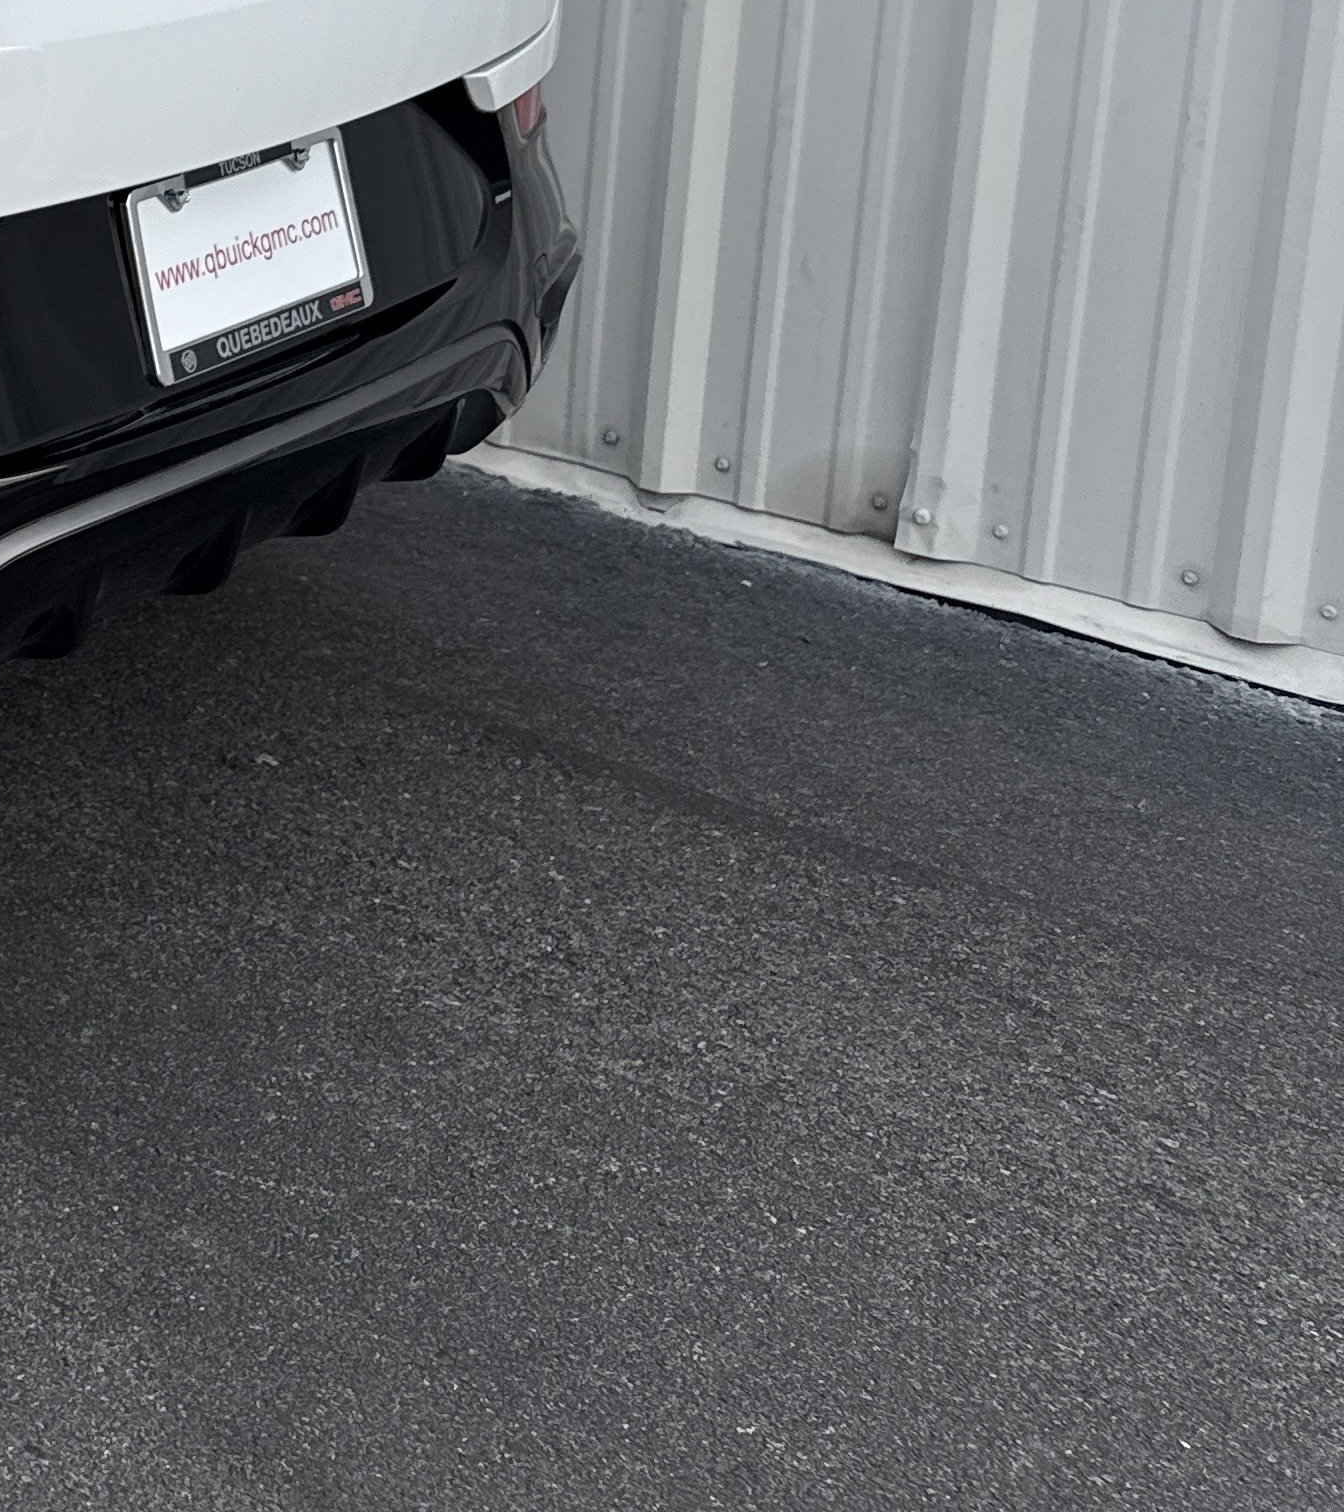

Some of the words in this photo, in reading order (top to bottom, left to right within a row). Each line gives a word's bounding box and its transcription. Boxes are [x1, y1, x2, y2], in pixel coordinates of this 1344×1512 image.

[218, 152, 262, 177] TUCSON
[155, 209, 340, 291] www.qbuickgmc.com
[216, 300, 323, 359] QUEBEDEAUX
[329, 288, 362, 312] GMC
